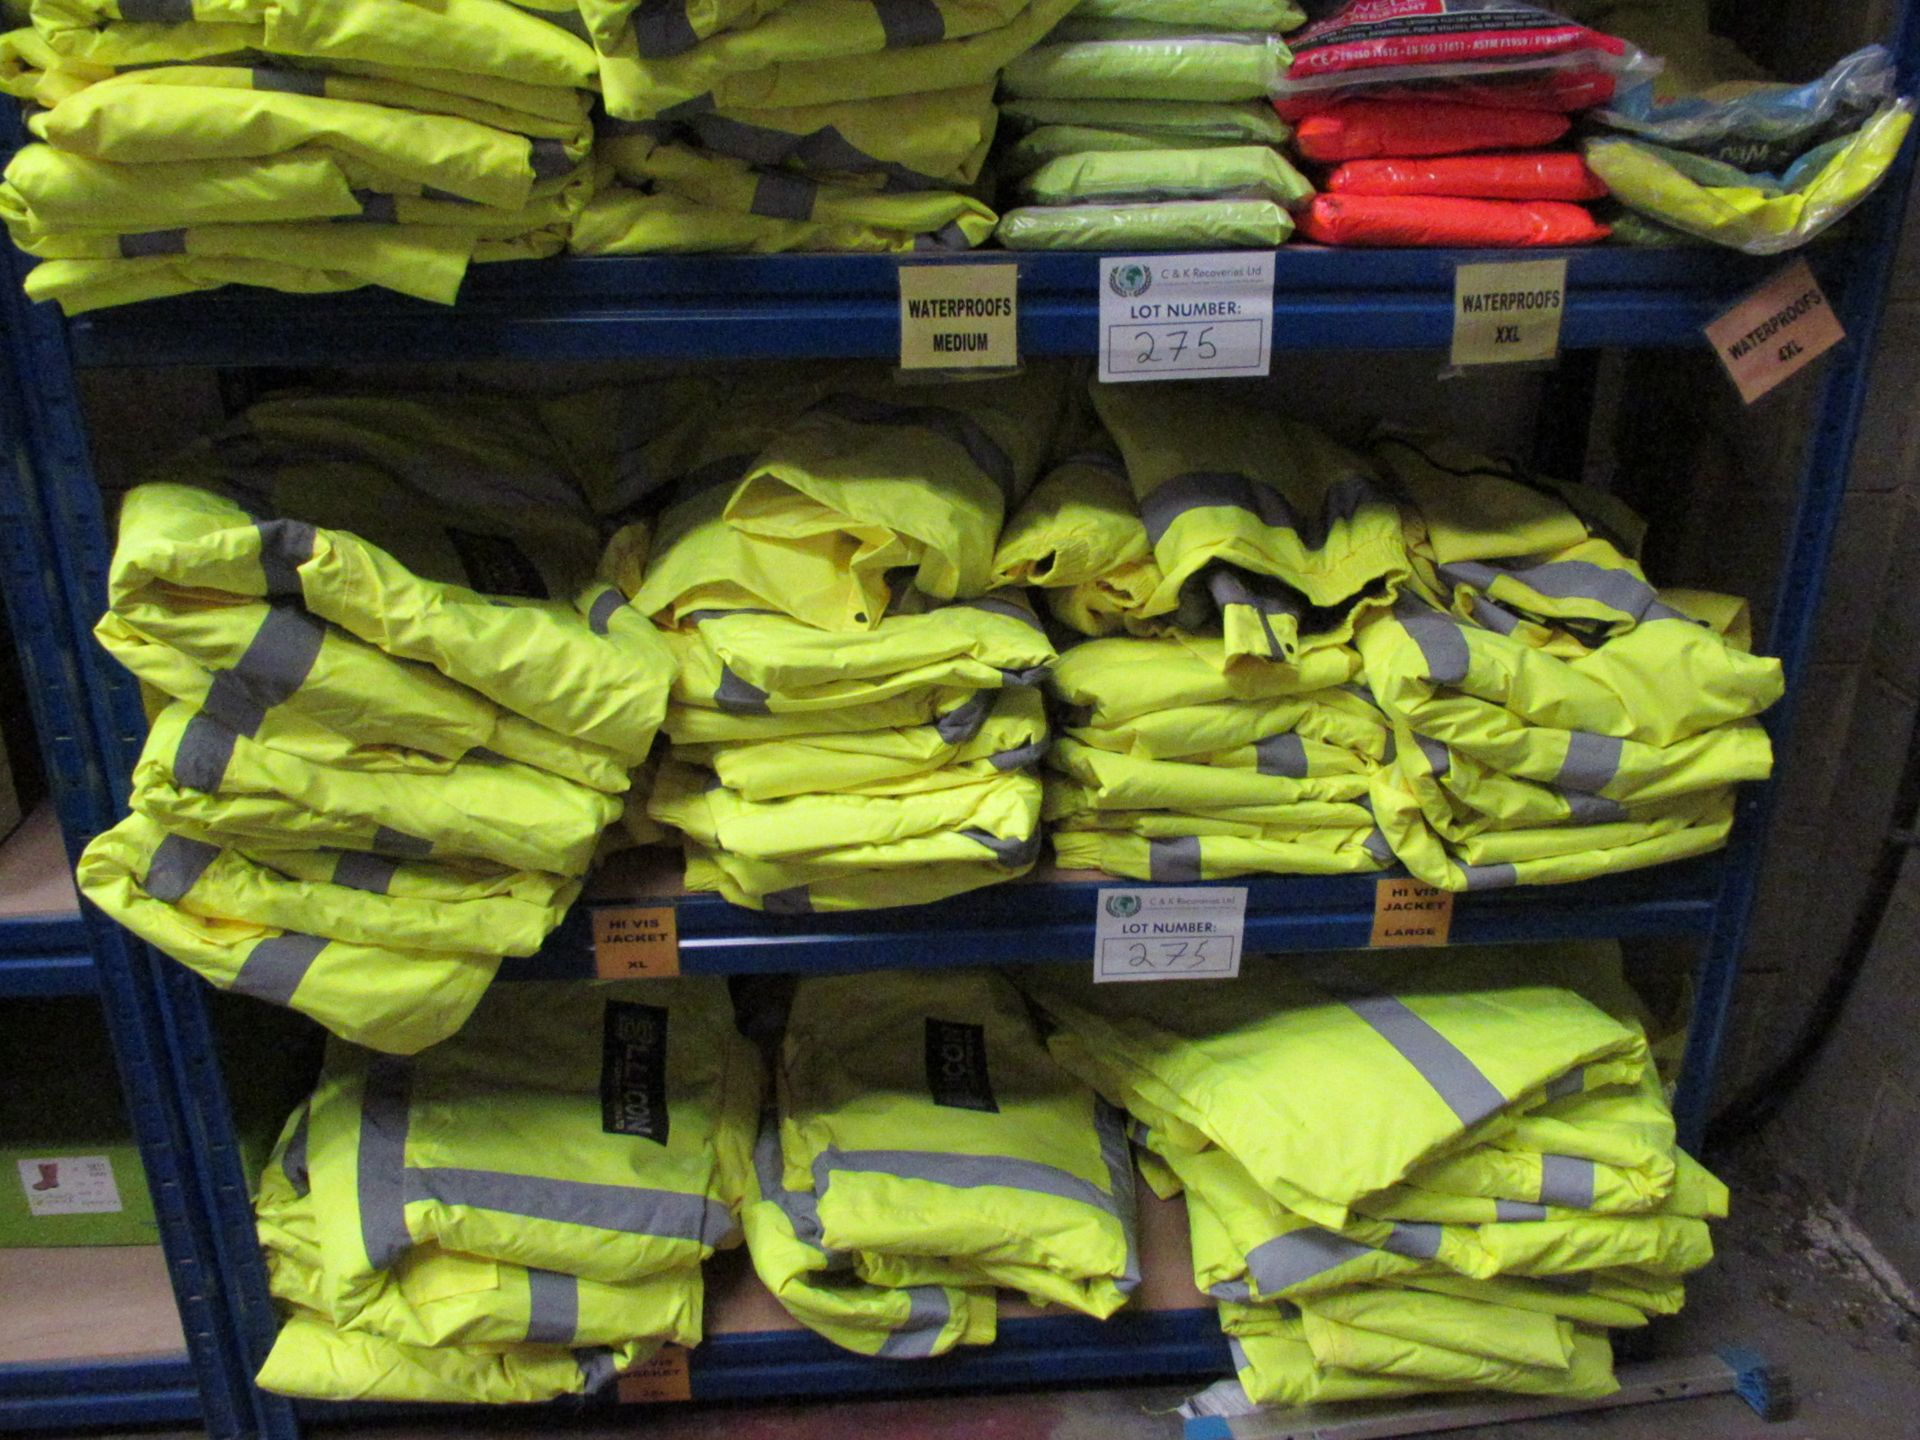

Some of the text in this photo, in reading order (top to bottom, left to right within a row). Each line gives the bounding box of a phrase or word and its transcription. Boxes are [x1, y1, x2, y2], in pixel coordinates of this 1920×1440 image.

[1161, 265, 1262, 279] C & K Recoveries Ltd
[908, 298, 1012, 318] WATERPROOFS
[1461, 289, 1560, 312] WATERPROOFS
[1131, 301, 1242, 319] LOT NUMBER:
[1727, 288, 1823, 361] WATERPROOFS
[933, 333, 988, 352] MEDIUM
[1494, 326, 1520, 344] XXL
[1134, 326, 1218, 364] 275
[1777, 340, 1805, 363] 4XL
[1392, 887, 1440, 897] HI VIS
[1383, 902, 1447, 912] JACKET
[609, 919, 660, 929] HI VIS
[1122, 922, 1217, 934] LOT NUMBER:
[1384, 927, 1437, 937] LARGE
[604, 933, 668, 943] JACKET
[1128, 939, 1208, 968] 275
[628, 960, 648, 970] XL
